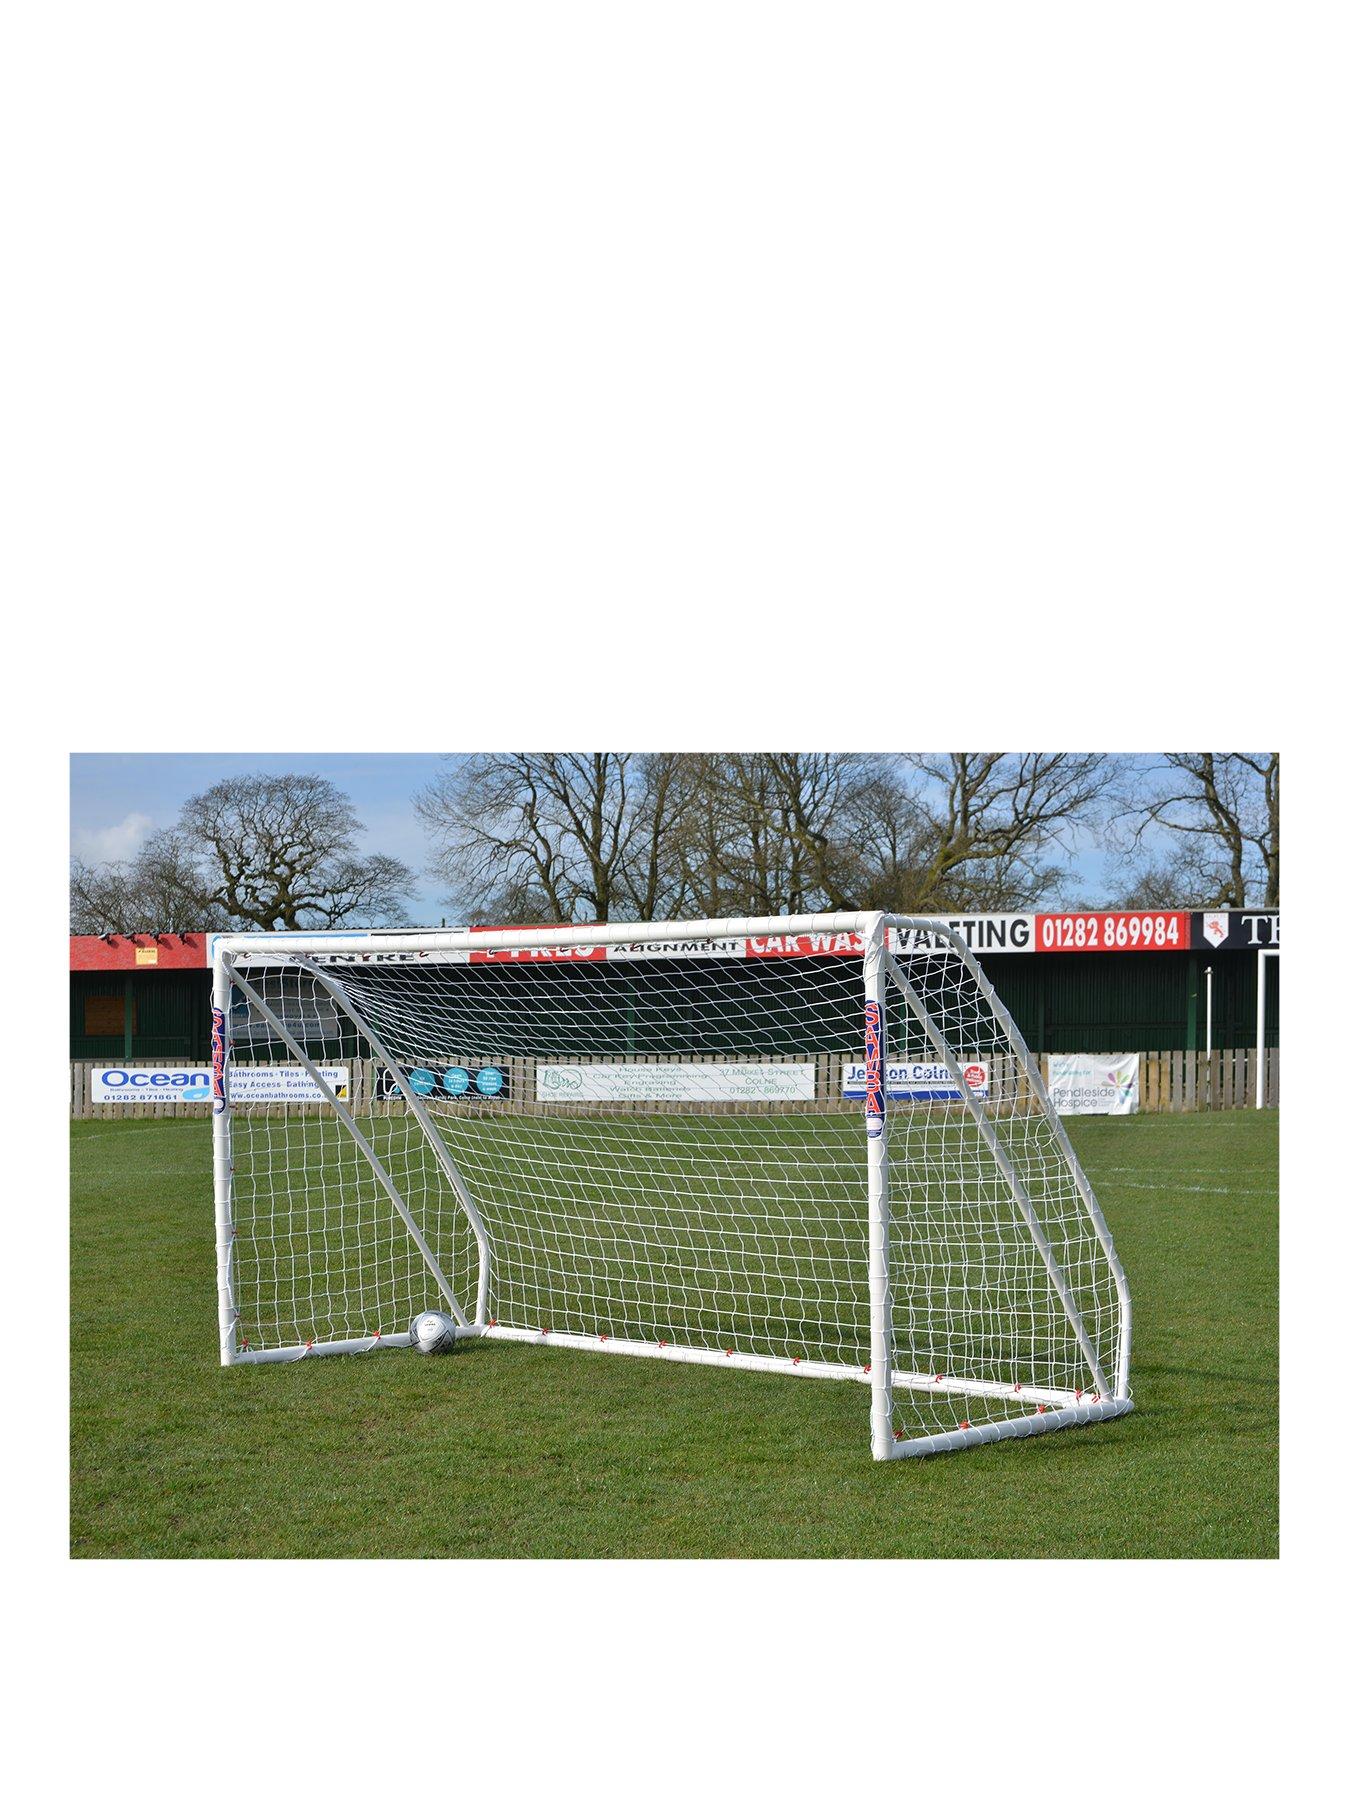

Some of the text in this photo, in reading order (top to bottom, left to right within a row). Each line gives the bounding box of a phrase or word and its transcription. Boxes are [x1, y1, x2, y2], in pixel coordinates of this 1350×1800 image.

[1042, 915, 1179, 947] 01282 869984
[809, 933, 865, 951] WAS
[865, 1002, 881, 1114] SAMBA
[101, 1070, 210, 1087] Ocean
[745, 1077, 777, 1085] COLNE
[1053, 1087, 1116, 1097] Pendleside
[1053, 1098, 1098, 1109] Hospice
